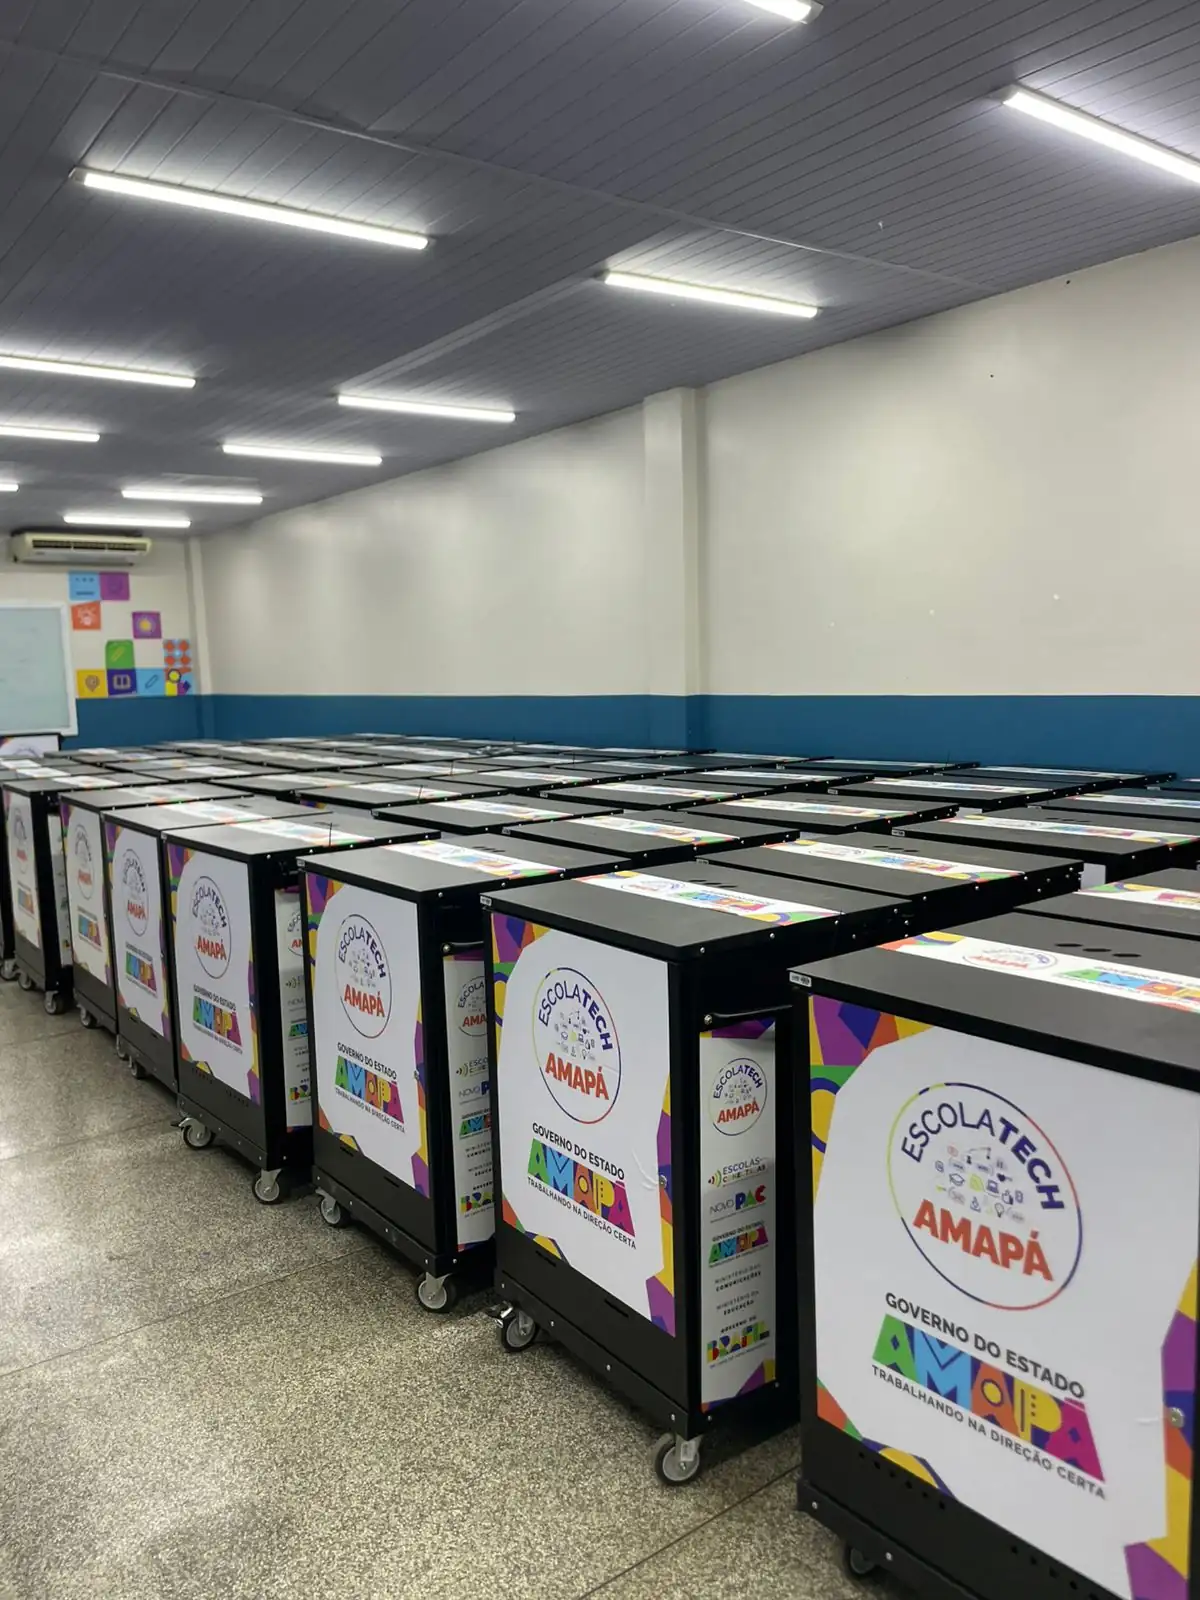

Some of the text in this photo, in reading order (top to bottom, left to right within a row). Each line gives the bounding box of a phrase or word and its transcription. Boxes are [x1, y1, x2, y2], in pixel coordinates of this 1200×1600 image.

[338, 925, 387, 979] ESCOLATECH
[344, 984, 386, 1018] AMAPÁ
[458, 981, 485, 1008] ESCOLA
[539, 980, 613, 1050] ESCOLATECH
[462, 1014, 487, 1027] AMA
[337, 1042, 397, 1082] GOVERNO DO ESTADO
[545, 1052, 610, 1101] AMAPÁ
[713, 1064, 763, 1099] ESCOLATECH
[717, 1097, 760, 1124] AMAPÁ
[532, 1122, 625, 1181] GOVERNO DO ESTADO
[722, 1157, 760, 1175] ESCOLAS
[901, 1101, 1065, 1209] ESCOLATECH
[527, 1176, 636, 1250] TRABALHANDO NA DIREÇÃO CERTA
[709, 1185, 766, 1215] NOVO PAC
[912, 1198, 1054, 1281] AMAPÁ
[886, 1292, 1085, 1399] GOVERNO DO ESTADO
[872, 1314, 1106, 1482] AMAPÁ
[872, 1364, 1107, 1501] TRABALHANDO NA DIREÇÃO CERTA
